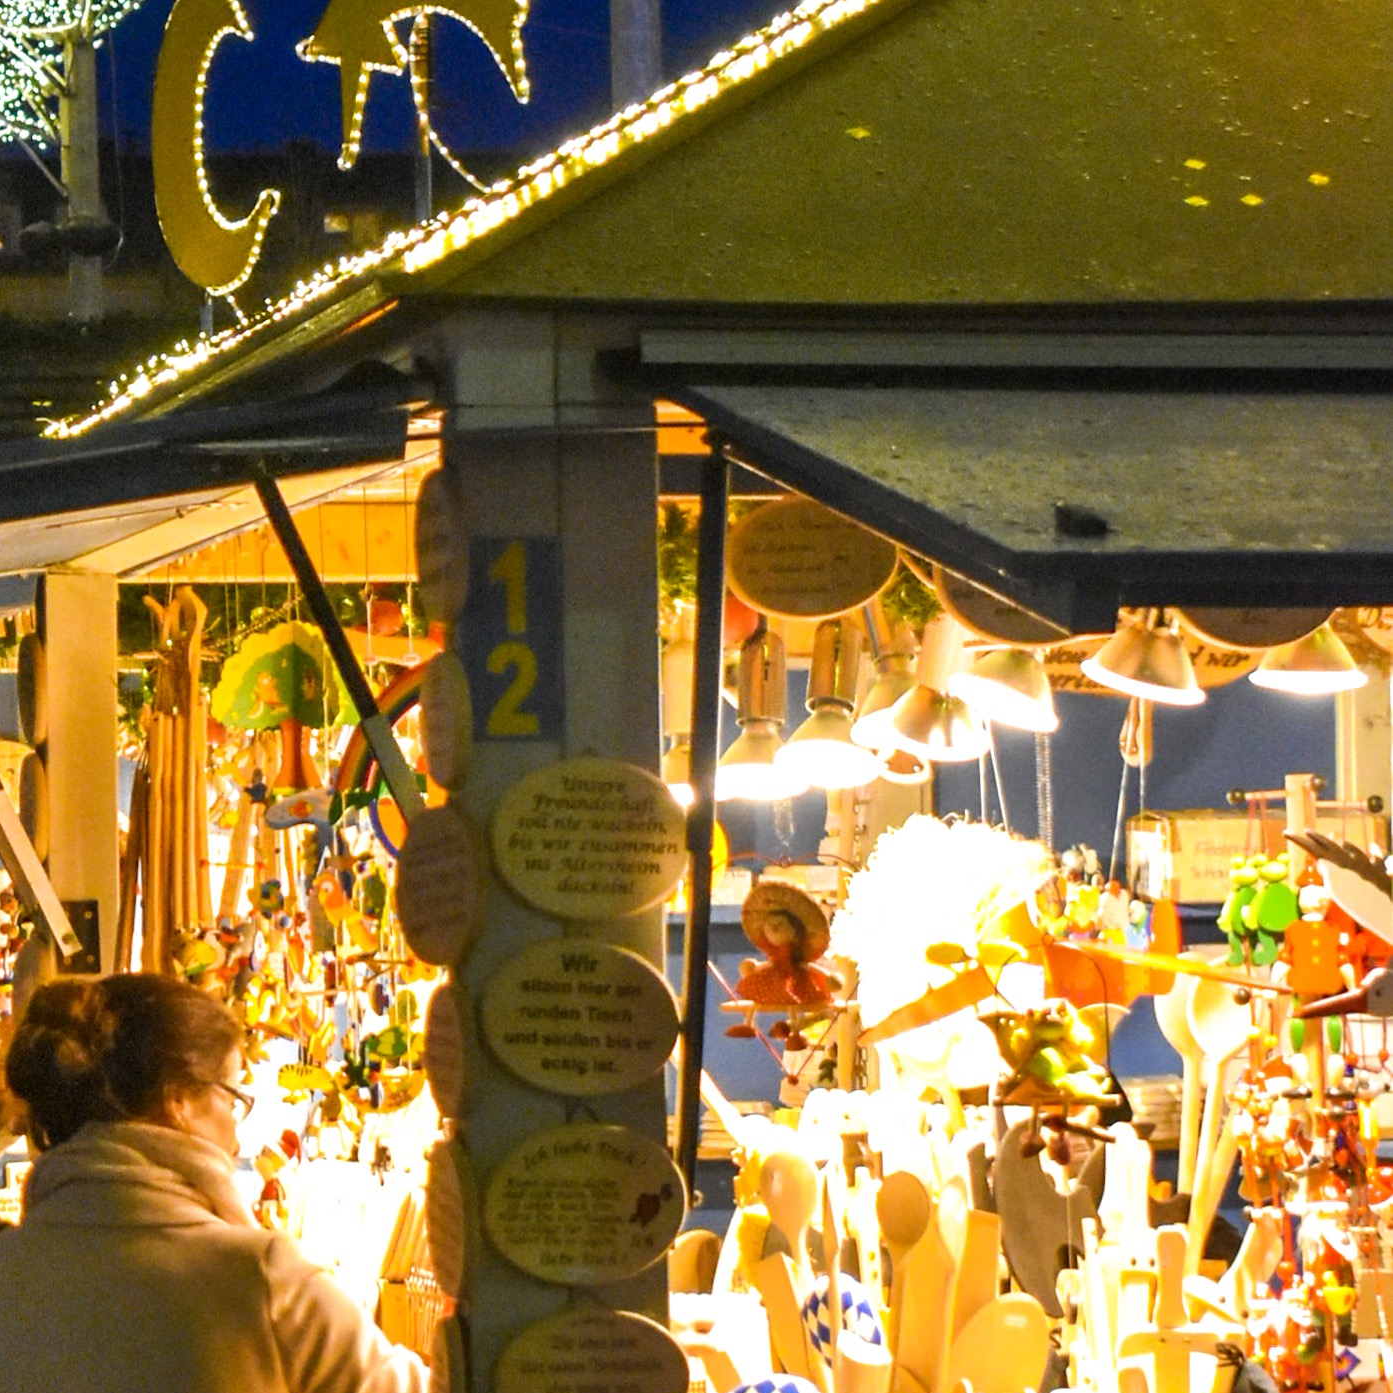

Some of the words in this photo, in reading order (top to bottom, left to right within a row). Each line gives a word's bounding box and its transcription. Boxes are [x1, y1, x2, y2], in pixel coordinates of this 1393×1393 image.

[561, 953, 599, 974] Wir
[520, 978, 573, 995] sitzen
[578, 980, 612, 996] hier
[519, 1004, 582, 1021] runden
[586, 1006, 633, 1023] Tisch
[504, 1030, 539, 1045] und
[542, 1032, 601, 1047] saufen
[605, 1035, 632, 1049] bis
[636, 1039, 656, 1050] er
[541, 1058, 588, 1076] eckig
